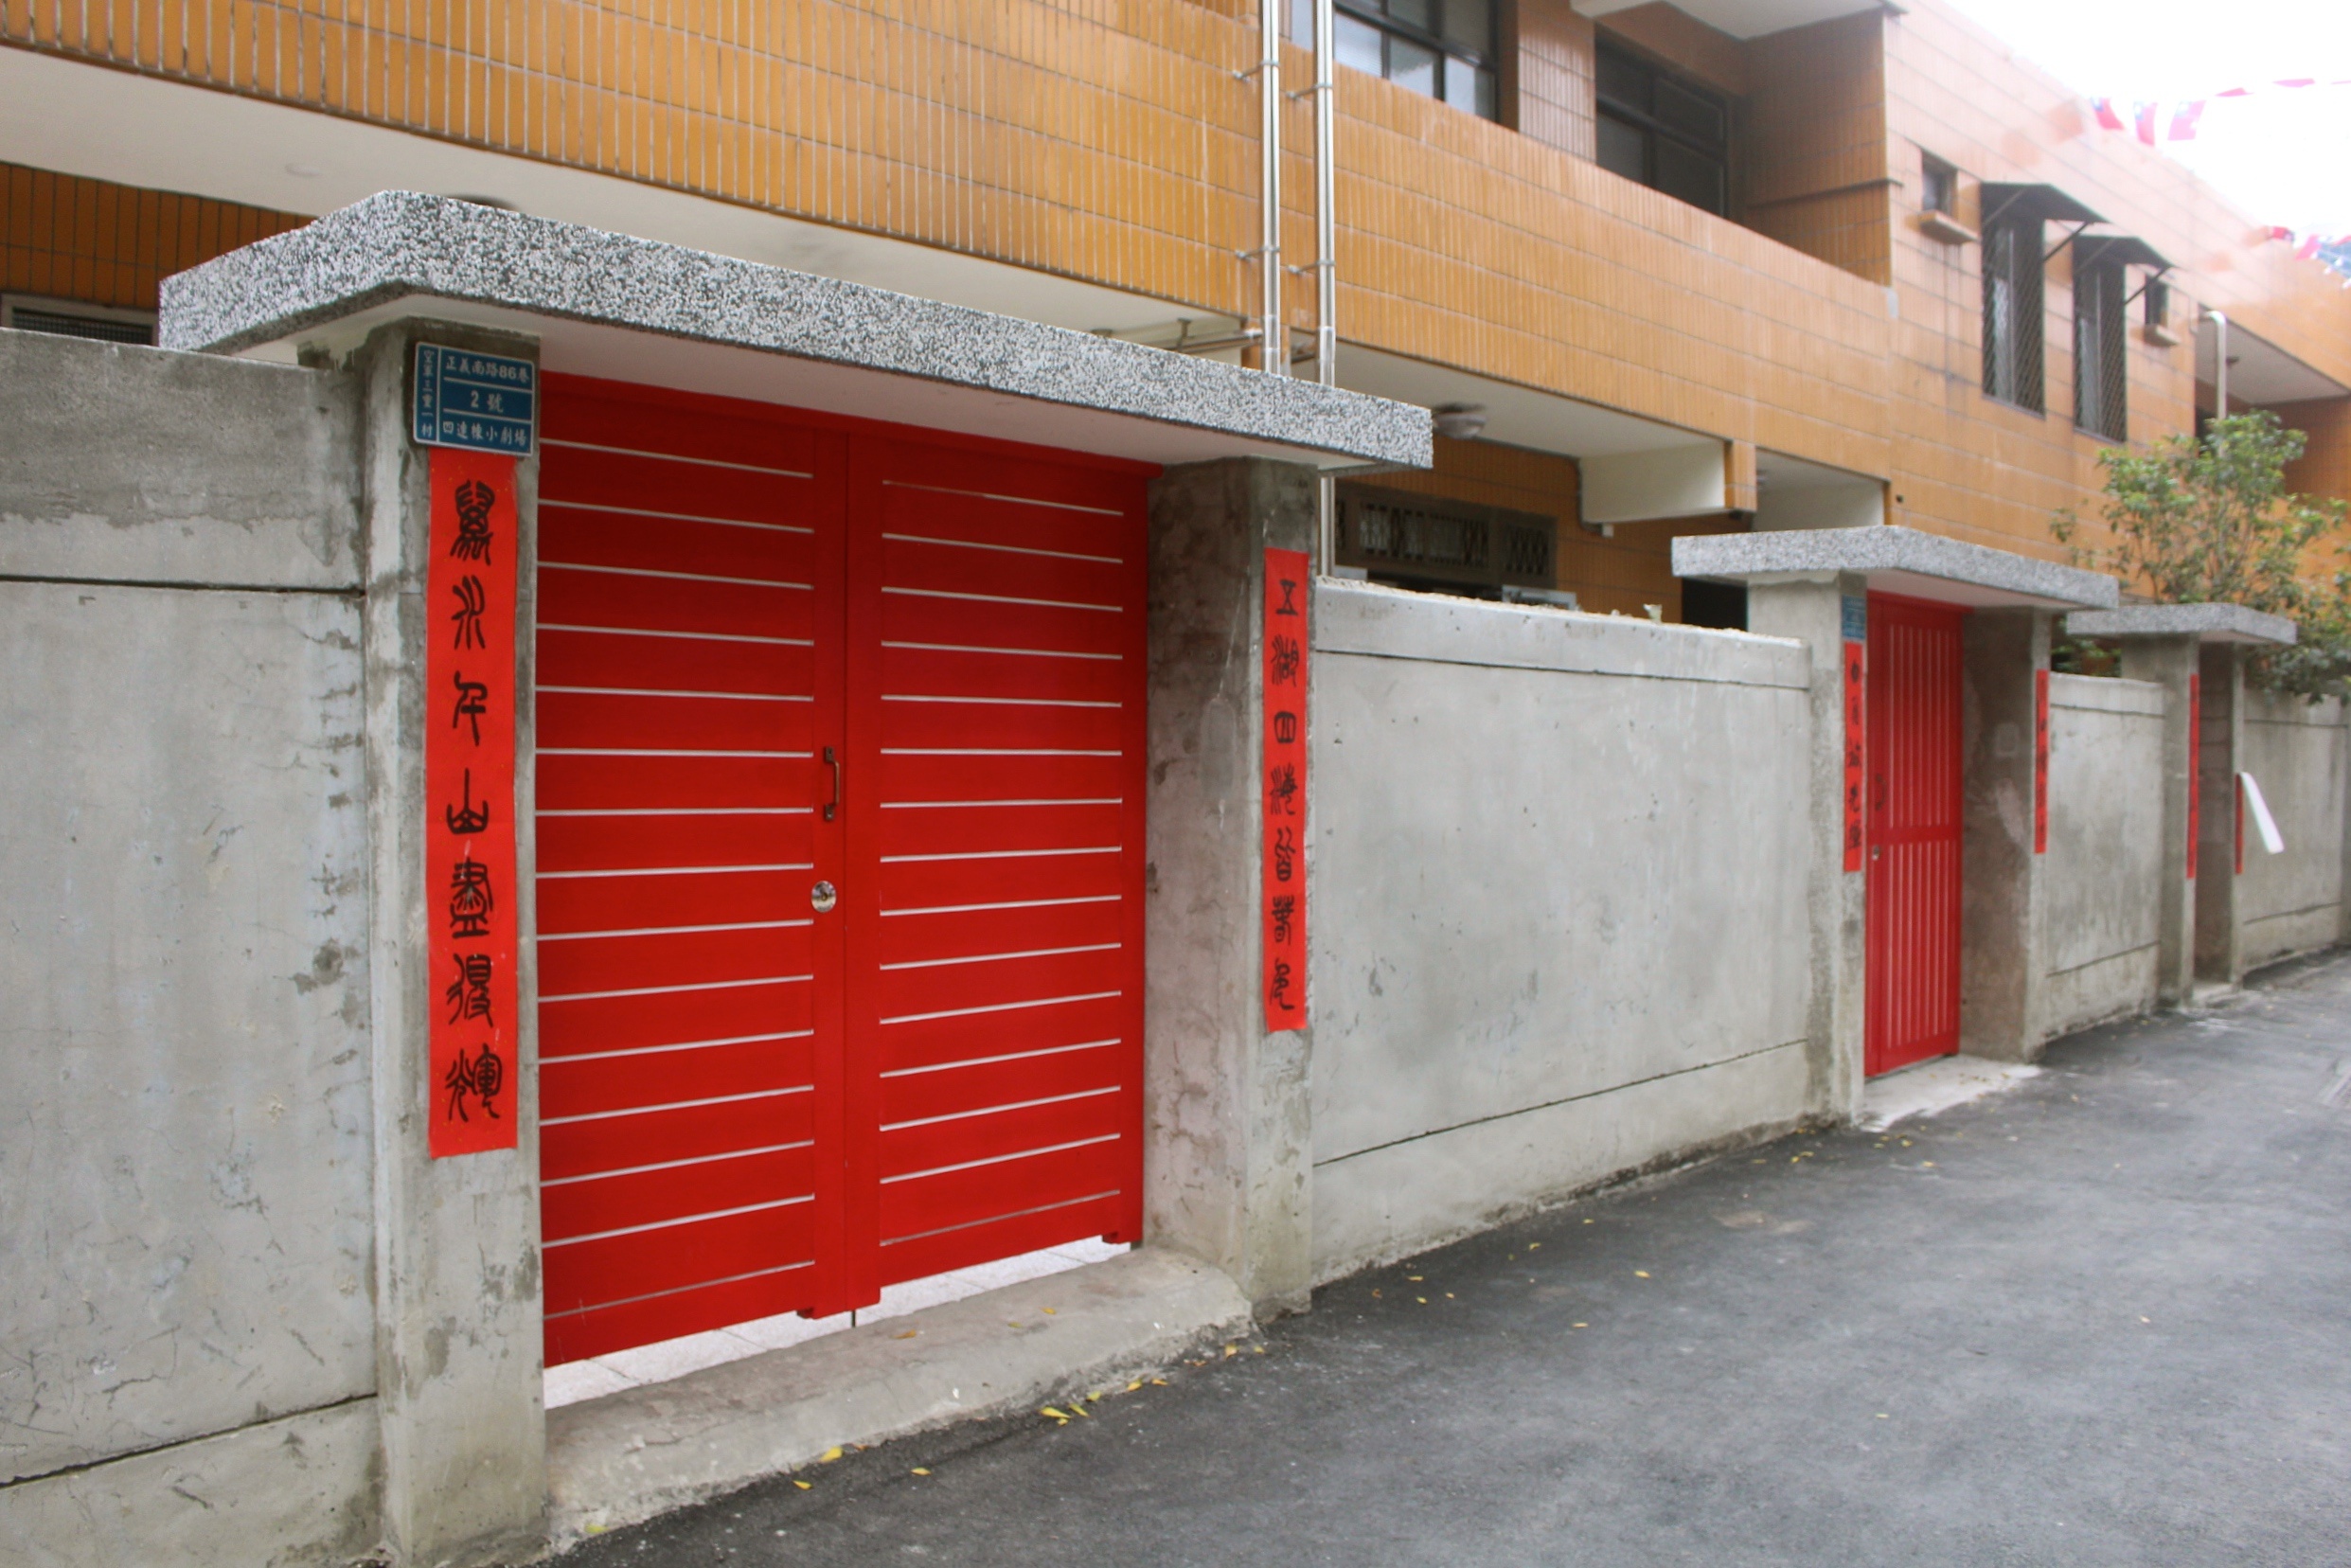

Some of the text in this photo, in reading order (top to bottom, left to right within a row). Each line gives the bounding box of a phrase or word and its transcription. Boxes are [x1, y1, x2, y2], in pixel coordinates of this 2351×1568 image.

[445, 356, 530, 383] 正義南路86巷
